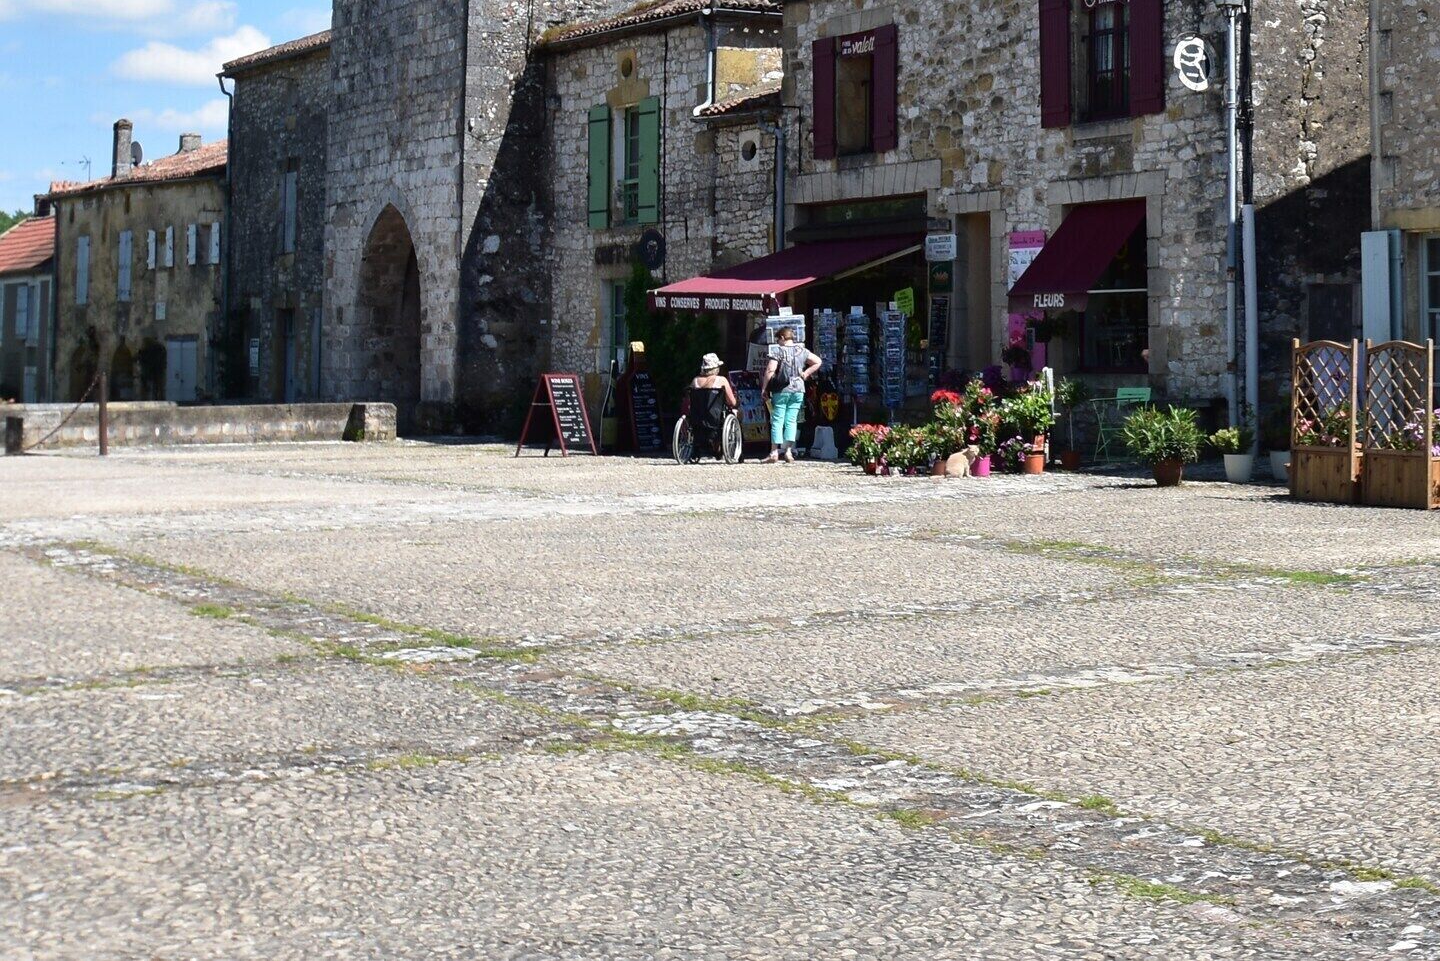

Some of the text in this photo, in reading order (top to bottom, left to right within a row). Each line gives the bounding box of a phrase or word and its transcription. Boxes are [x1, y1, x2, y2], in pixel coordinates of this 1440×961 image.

[655, 296, 764, 311] VINS CONSERVES PRODUITS REGIONAUX
[1033, 293, 1064, 308] FLEURS
